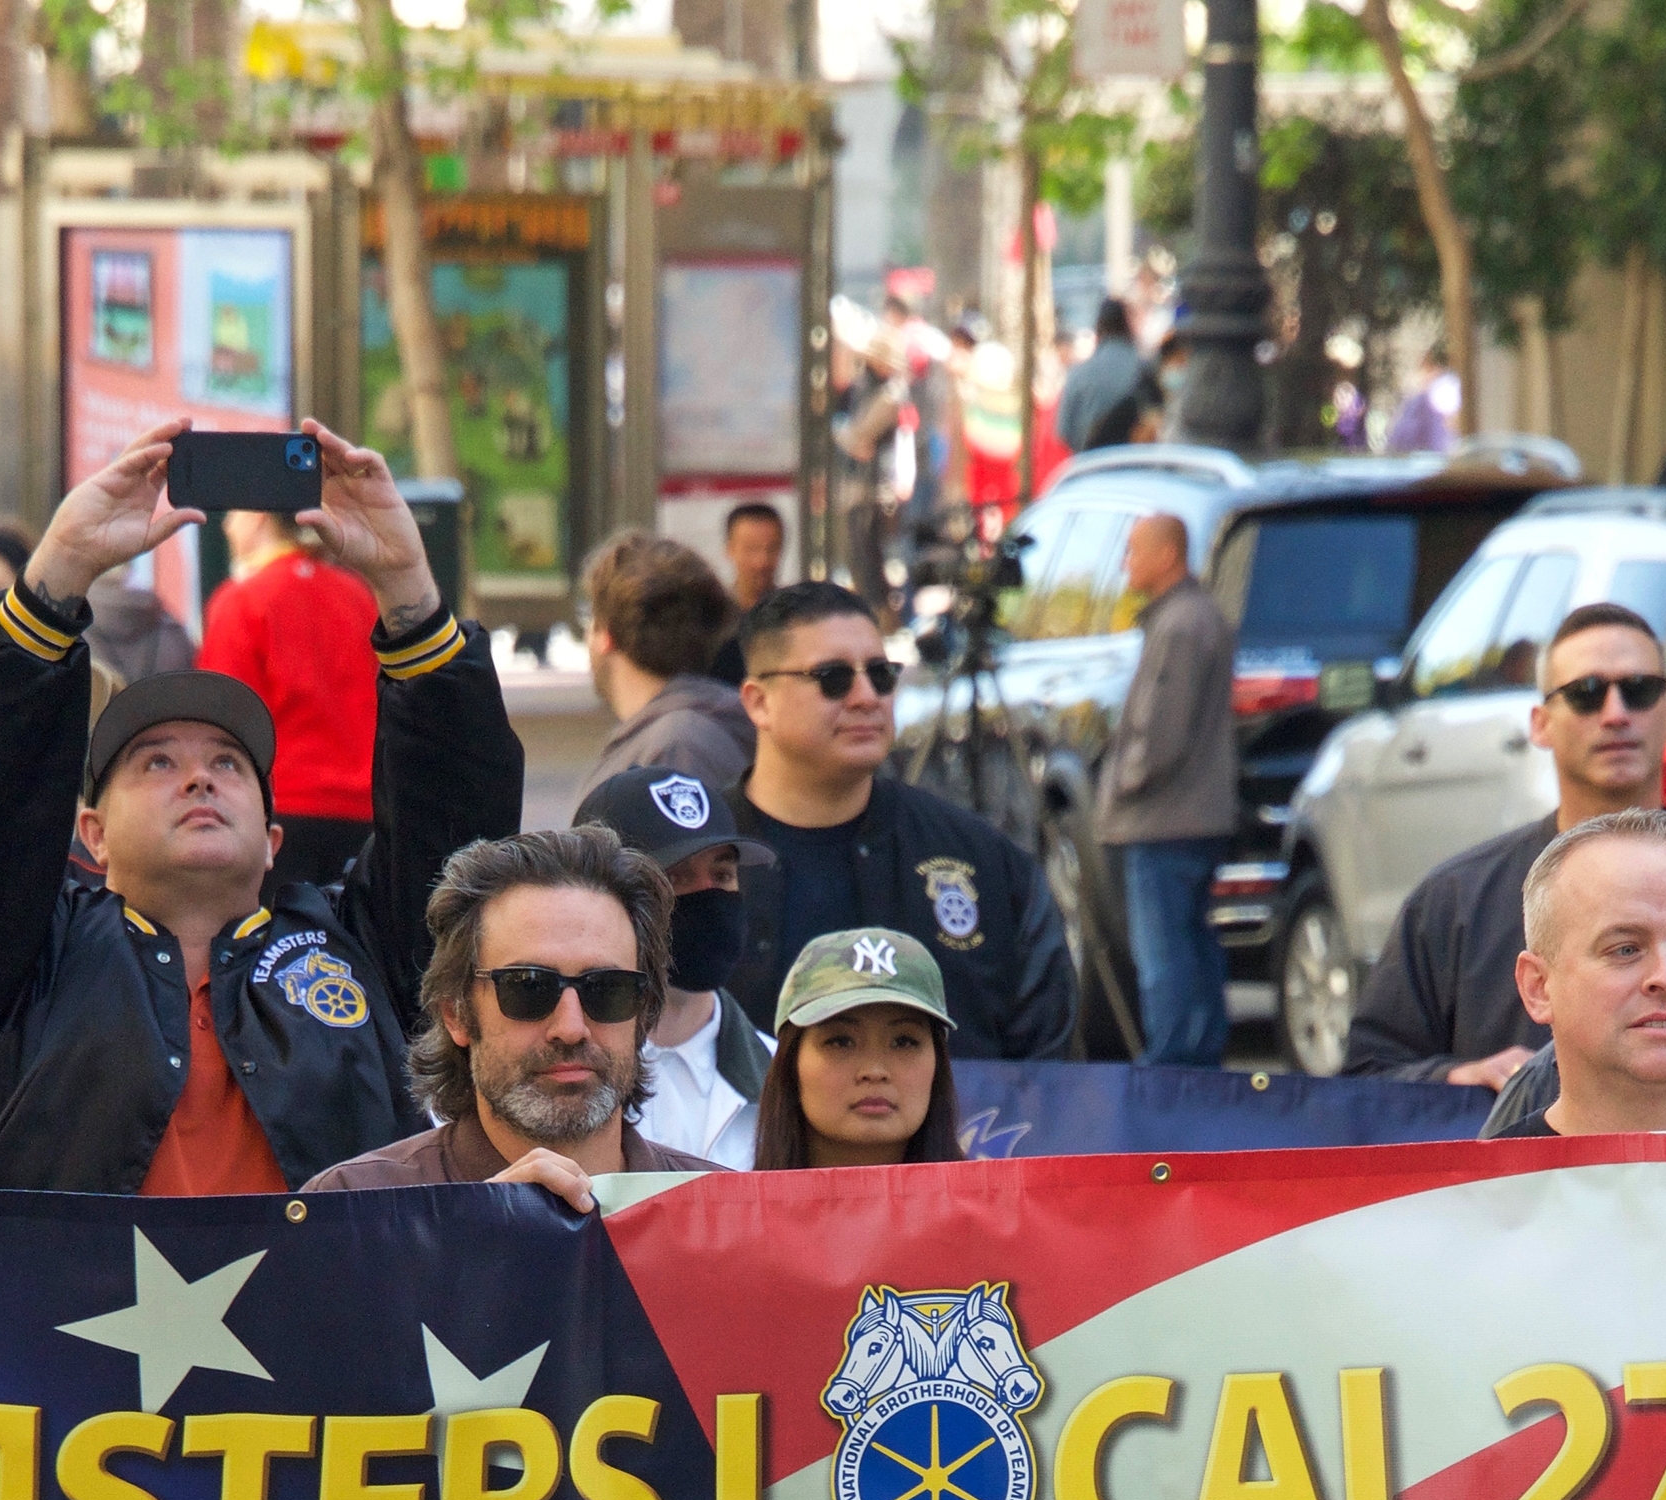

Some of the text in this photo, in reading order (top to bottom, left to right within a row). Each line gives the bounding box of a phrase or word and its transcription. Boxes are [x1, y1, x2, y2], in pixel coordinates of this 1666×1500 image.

[252, 930, 328, 985] TEAMSTERS
[852, 935, 899, 977] NY
[876, 1383, 1000, 1421] BROTHERHOOD
[996, 1418, 1016, 1441] OF
